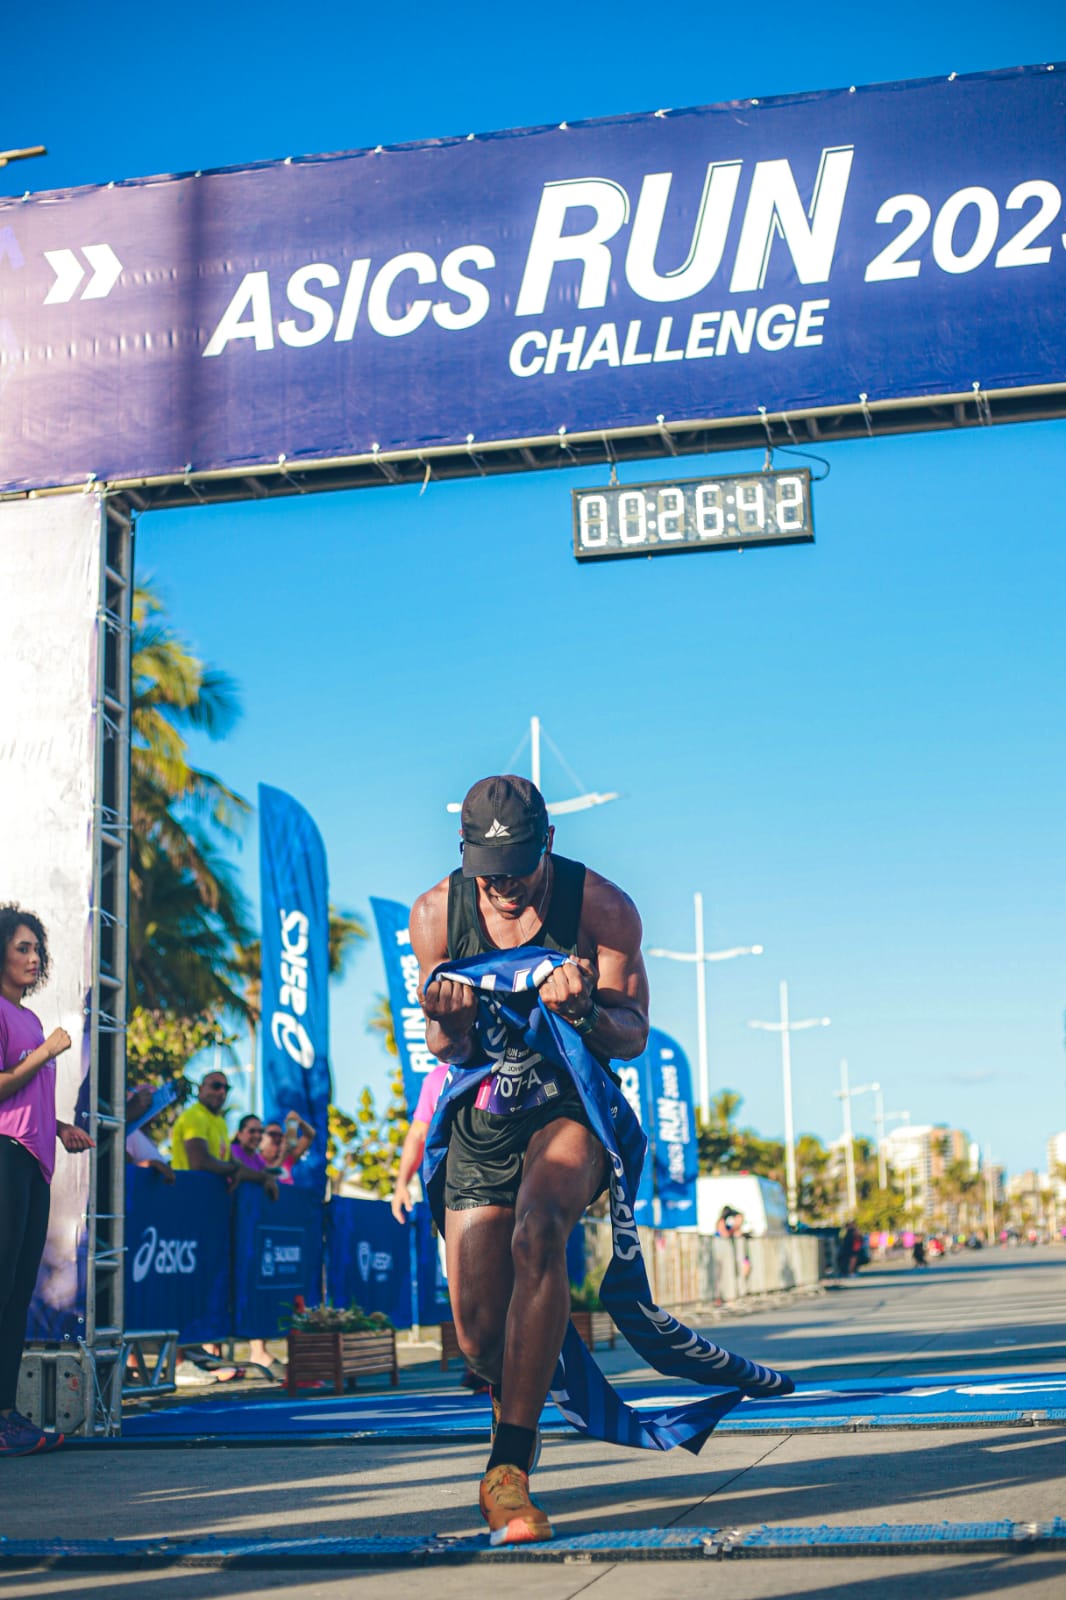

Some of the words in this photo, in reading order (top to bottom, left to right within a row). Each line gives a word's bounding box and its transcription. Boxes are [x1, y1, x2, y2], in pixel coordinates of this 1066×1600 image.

[203, 244, 496, 357] ASICS
[516, 144, 855, 316] RUN
[864, 180, 1066, 282] 202
[509, 299, 830, 377] CHALLENGE
[580, 476, 804, 548] 00:26:42
